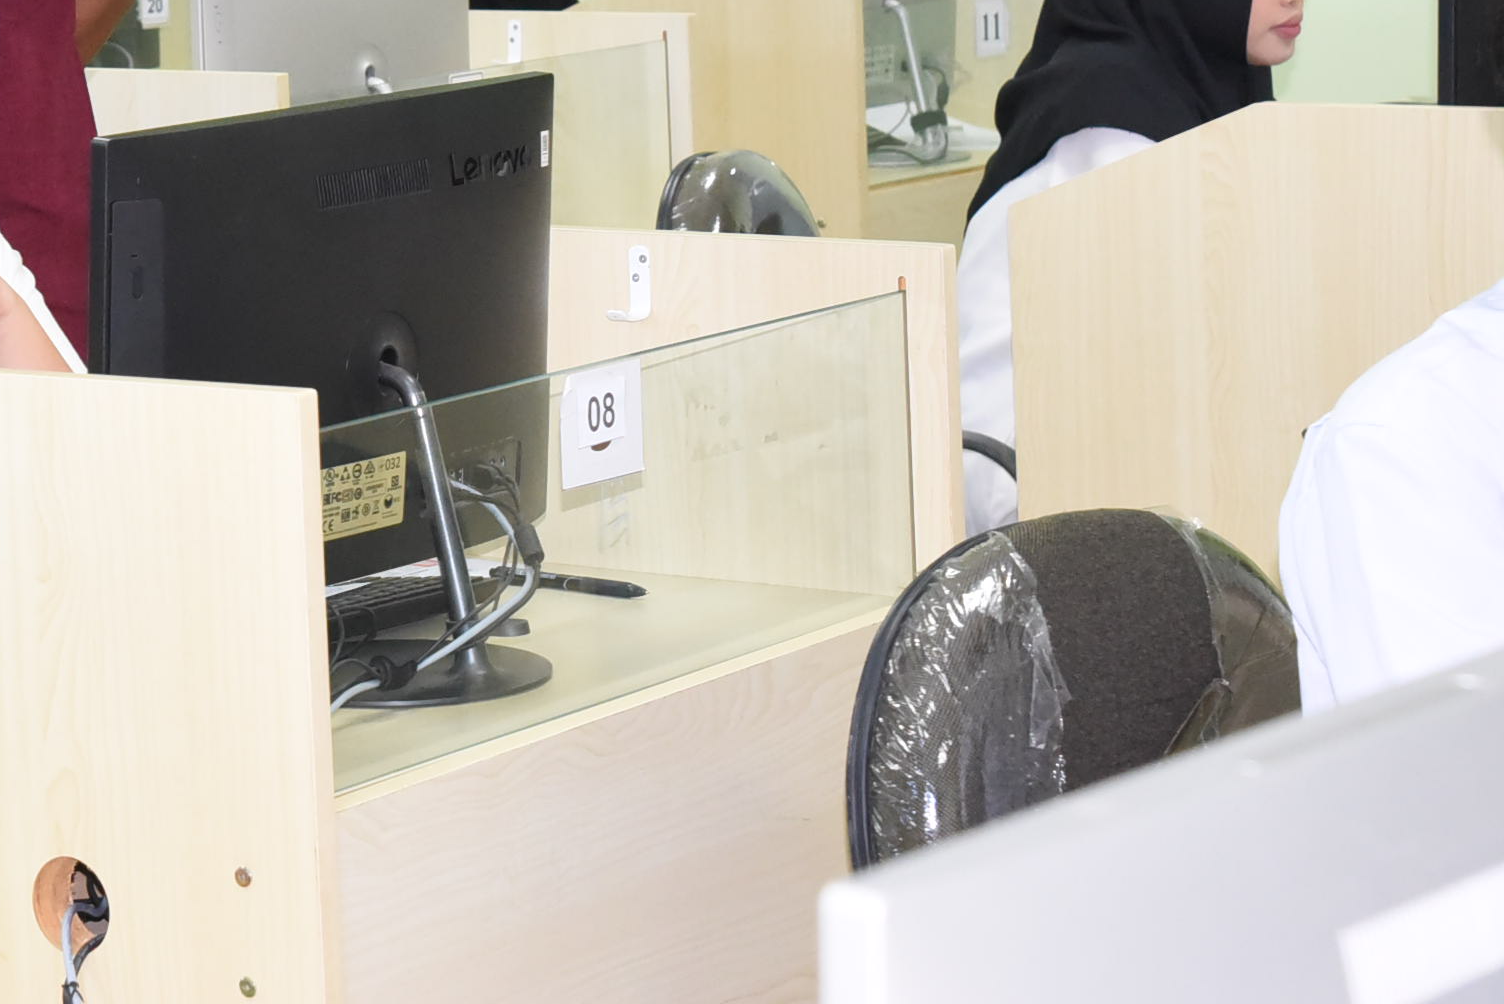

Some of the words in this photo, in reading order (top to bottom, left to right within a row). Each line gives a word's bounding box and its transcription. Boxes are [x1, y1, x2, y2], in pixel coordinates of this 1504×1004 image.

[983, 12, 1000, 41] 11
[588, 392, 615, 432] 08
[385, 457, 401, 471] 032
